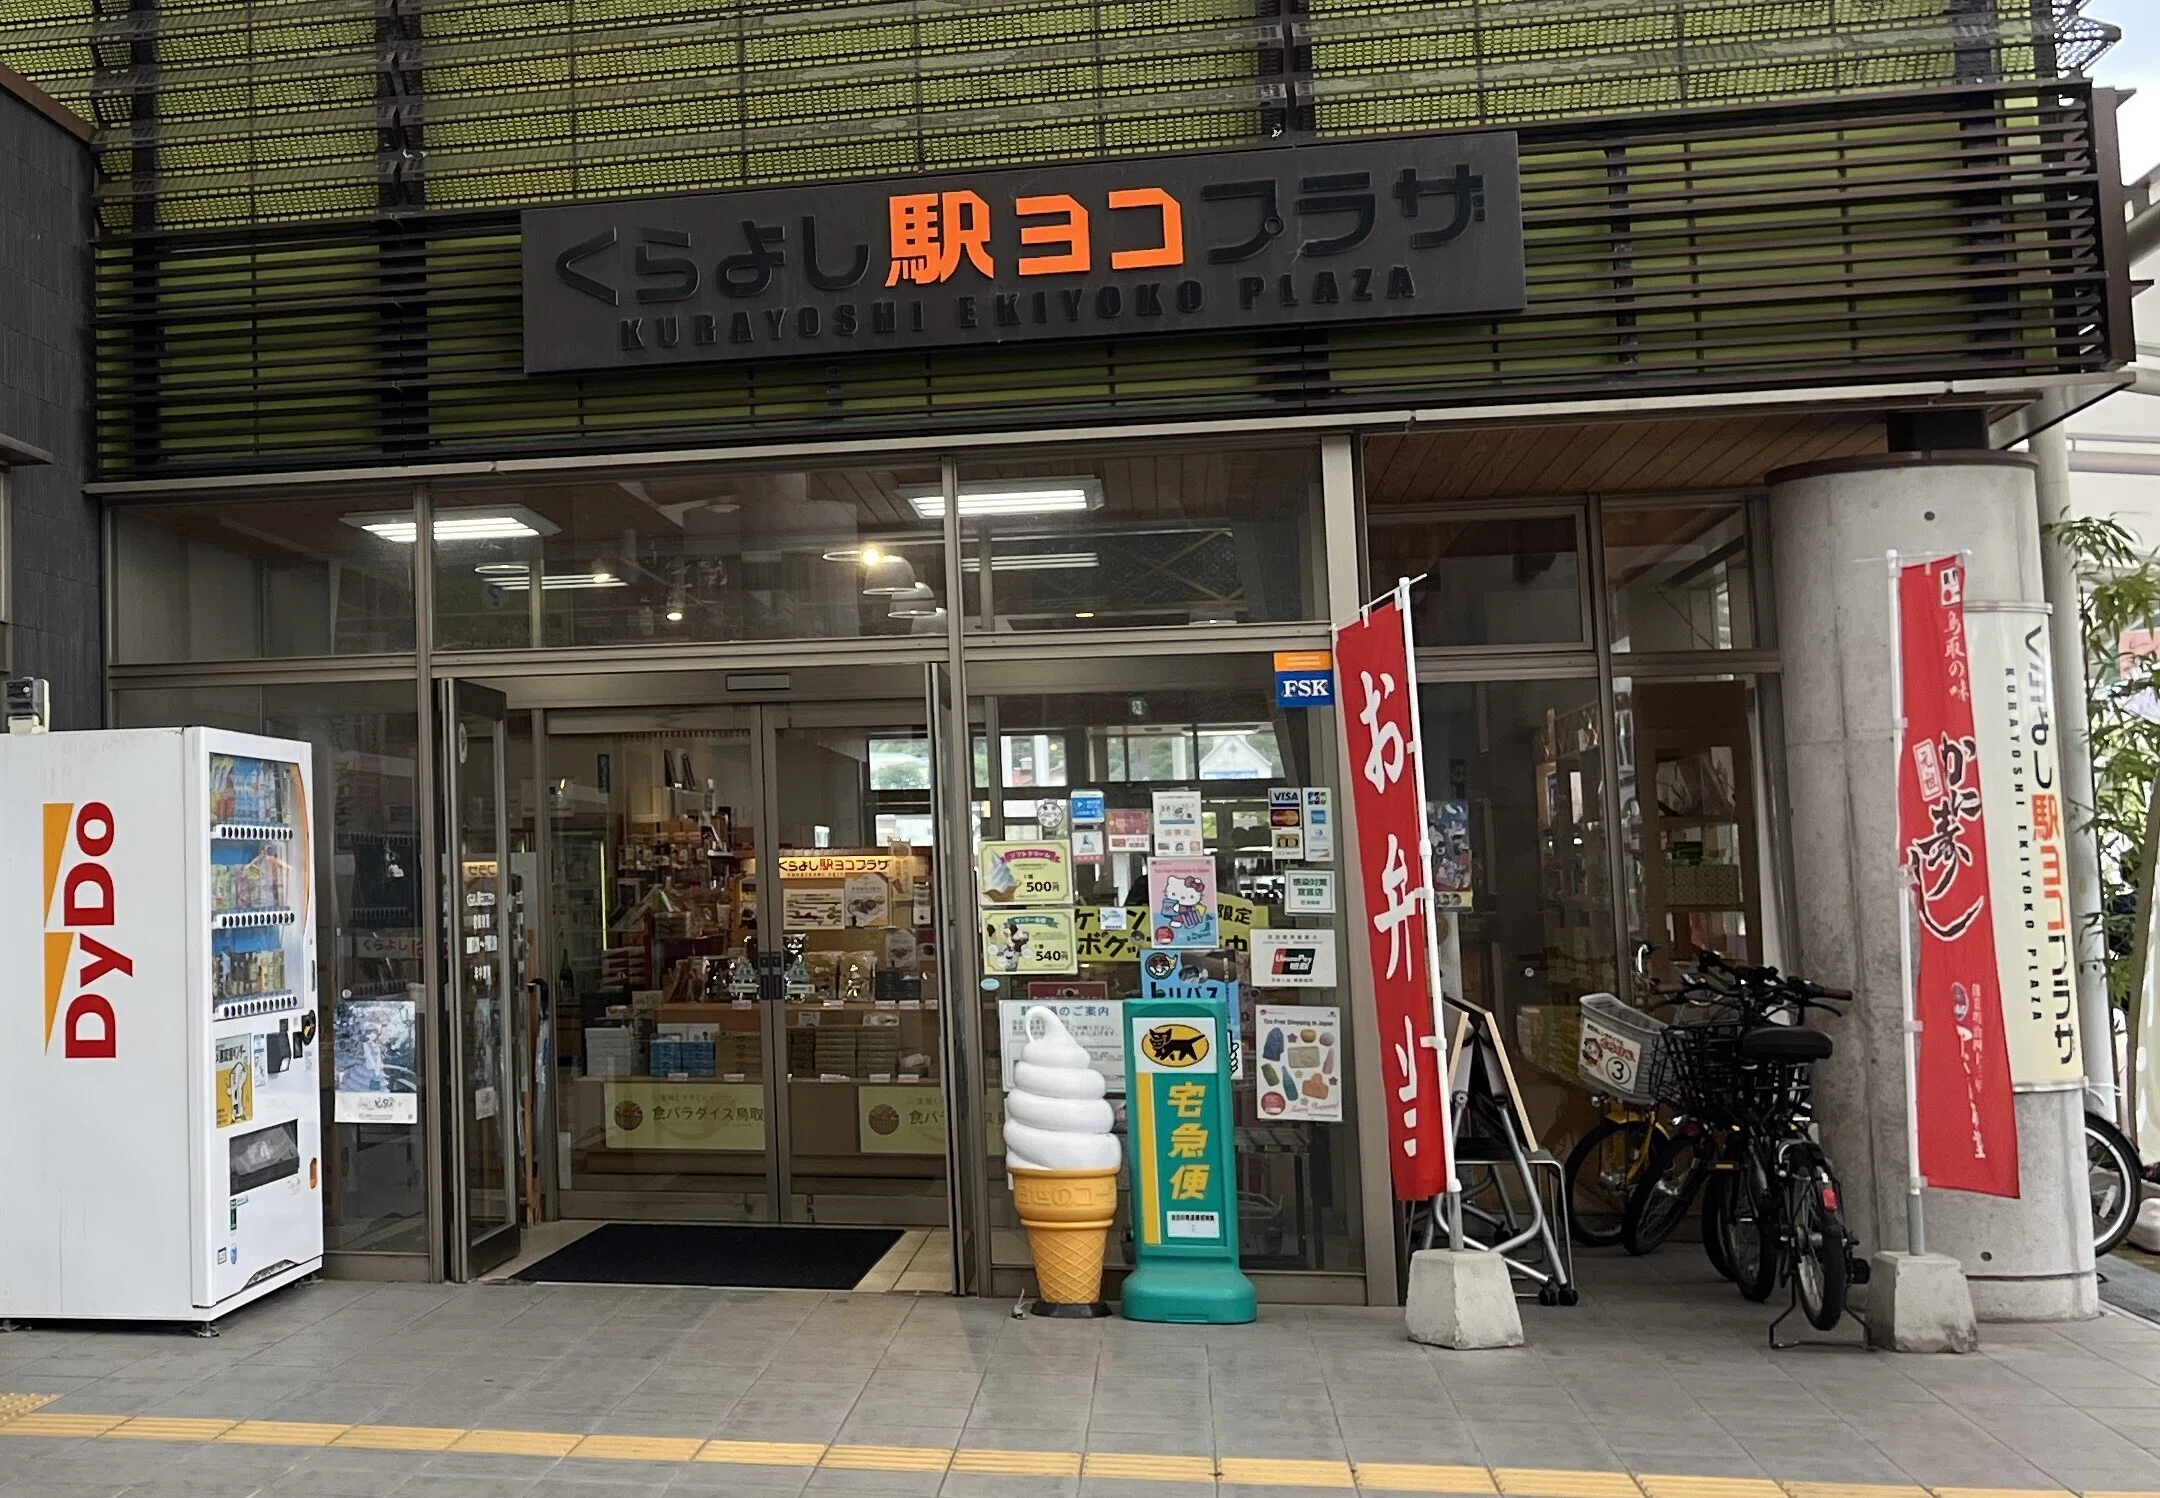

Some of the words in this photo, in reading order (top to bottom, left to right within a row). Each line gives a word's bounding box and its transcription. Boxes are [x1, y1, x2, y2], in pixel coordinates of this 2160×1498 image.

[554, 163, 1486, 307] くらよし駅ヨコプラザ
[619, 301, 924, 349] KURAYOSHI
[958, 279, 1204, 328] EKIYOKO
[1239, 266, 1416, 310] PLAZA
[1282, 680, 1330, 698] FSK
[1273, 792, 1298, 801] VISA
[2005, 667, 2026, 806] KURAYOSHI
[2018, 824, 2035, 929] EKIYOKO
[2027, 948, 2043, 1021] PLAZA
[64, 801, 134, 1060] DyDo
[1166, 1081, 1212, 1201] 宅急便
